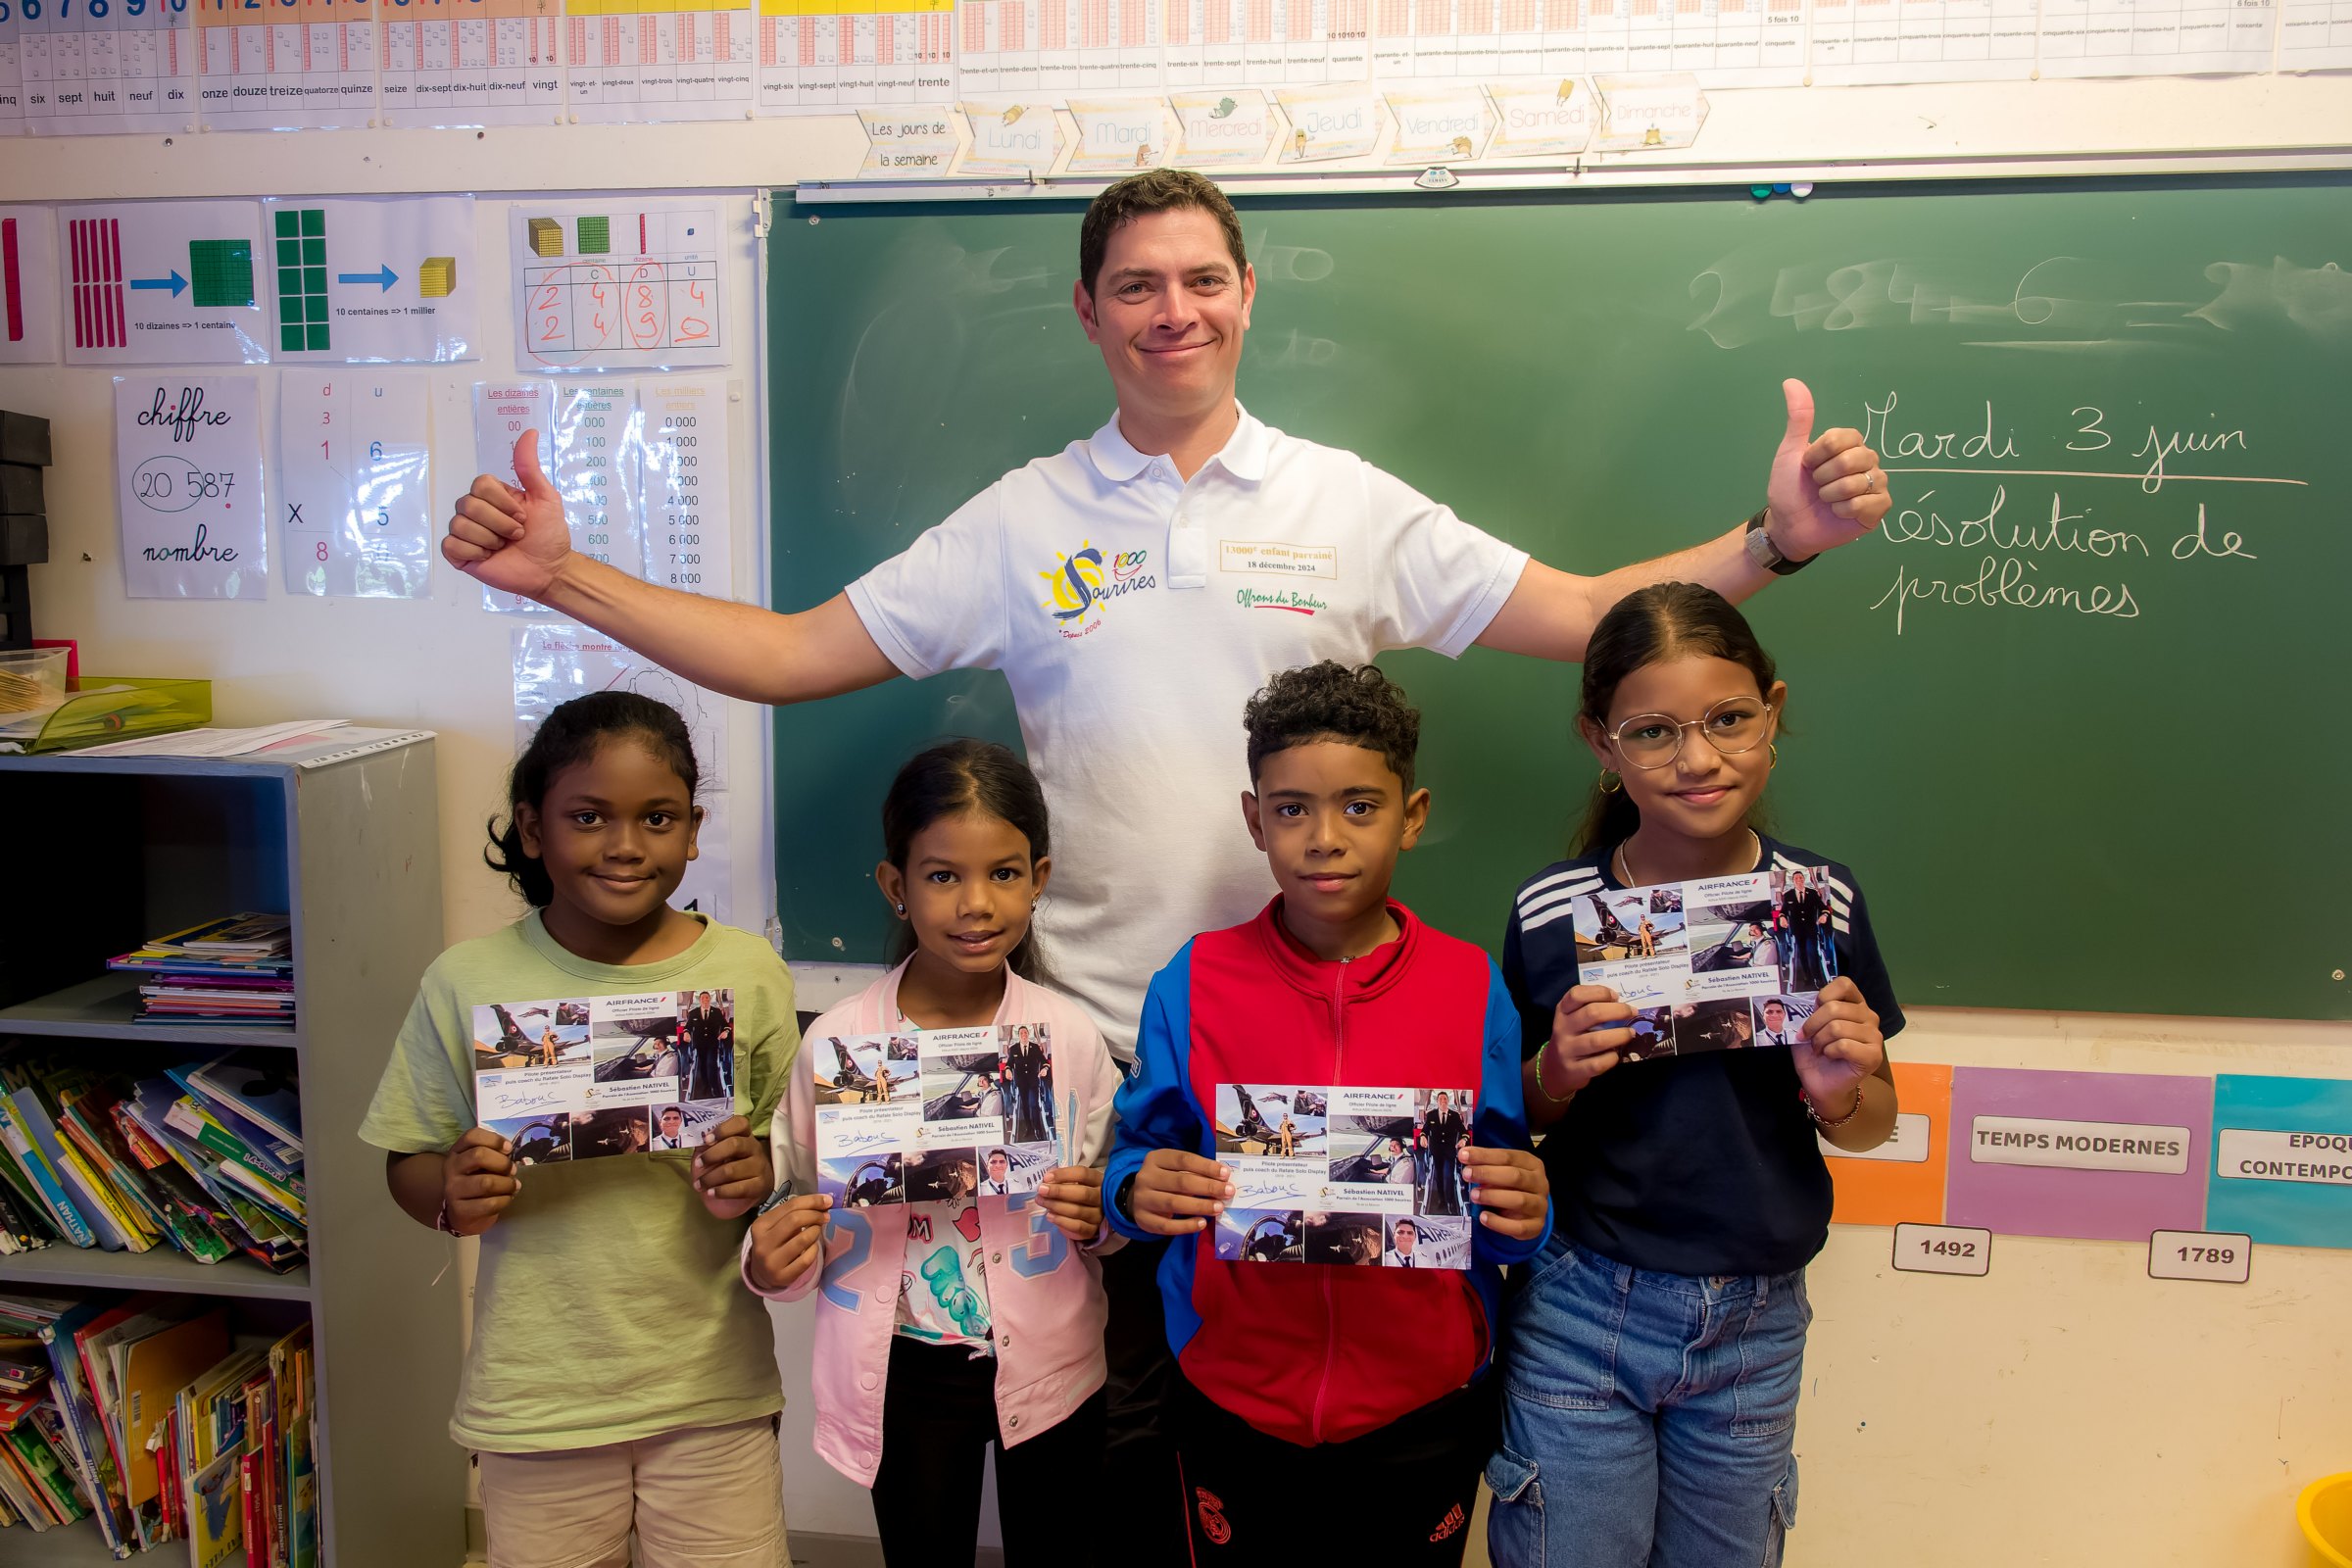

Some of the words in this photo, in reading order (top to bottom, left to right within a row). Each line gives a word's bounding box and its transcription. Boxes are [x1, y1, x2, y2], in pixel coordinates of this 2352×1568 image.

[416, 82, 452, 94] dix-sept
[453, 82, 487, 92] dix-huit
[489, 80, 526, 90] dix-neuf
[532, 79, 558, 91] vingt
[763, 82, 794, 91] vingt-six
[799, 81, 836, 90] vingt-sept
[839, 79, 874, 88] vingt-huit
[877, 79, 915, 89] vingt-neuf
[917, 77, 950, 87] trente
[168, 88, 184, 100] dix
[202, 89, 228, 99] onze
[233, 86, 268, 97] douze
[270, 85, 304, 96] treize
[304, 86, 339, 96] quatorze
[340, 83, 373, 95] quinze
[30, 94, 45, 104] six
[59, 91, 83, 106] sept
[94, 91, 116, 102] huit
[129, 90, 153, 101] neuf
[1509, 104, 1585, 128] Samedi
[1617, 104, 1691, 120] Dimanche
[1306, 107, 1362, 133] Jeudi
[1406, 114, 1479, 134] Vendredi
[872, 122, 893, 135] Les
[899, 122, 928, 137] jours
[933, 122, 947, 134] de
[1096, 122, 1152, 143] Mardi
[1191, 117, 1262, 139] Mercredi
[989, 128, 1041, 149] Lundi
[880, 154, 890, 166] la
[895, 153, 939, 166] semaine
[590, 270, 600, 280] C
[640, 269, 649, 278] D
[687, 267, 696, 276] U
[539, 285, 562, 311] 2
[592, 281, 606, 308] 4
[639, 285, 654, 309] 8
[690, 281, 705, 308] 4
[335, 308, 346, 317] 10
[348, 307, 389, 317] centaines
[411, 306, 436, 316] millier
[134, 322, 145, 331] 10
[146, 320, 180, 330] dizaines
[541, 316, 565, 340] 2
[594, 313, 607, 337] 4
[635, 312, 658, 338] 9
[322, 382, 331, 397] d
[374, 386, 383, 397] u
[488, 389, 504, 399] Les
[505, 388, 540, 399] dizaines
[137, 387, 231, 442] chiffre
[497, 404, 531, 416] entières
[321, 412, 331, 425] 3
[584, 416, 606, 428] 000
[665, 416, 672, 427] 0
[676, 416, 697, 427] 000
[508, 420, 521, 432] 00
[586, 436, 606, 448] 100
[1862, 390, 2020, 461] Mardi
[2066, 406, 2111, 450] 3
[2132, 424, 2248, 494] juin
[321, 439, 329, 460] 1
[369, 441, 382, 461] 6
[586, 456, 607, 467] 200
[140, 471, 172, 498] 20
[187, 471, 236, 498] 587
[588, 514, 609, 525] 500
[588, 534, 609, 545] 600
[2172, 503, 2258, 566] de
[143, 523, 239, 563] nombre
[317, 541, 329, 562] 8
[1260, 547, 1290, 558] enfant
[1293, 551, 1333, 563] parrainé
[1113, 550, 1148, 568] 1000
[1248, 561, 1257, 569] 18
[1259, 562, 1297, 572] décembre
[1298, 564, 1316, 573] 2024
[670, 573, 677, 584] 8
[680, 573, 702, 585] 000
[1052, 548, 1156, 621] Sourires
[1237, 588, 1274, 609] Offrons
[1275, 591, 1289, 605] du
[1292, 592, 1328, 611] Bonheur
[1870, 555, 2140, 635] problèmes
[1062, 630, 1083, 641] Depuis
[1085, 618, 1102, 634] 2006
[582, 642, 612, 652] montre
[1697, 879, 1750, 891] AIRFRANCE
[1741, 971, 1770, 981] NATIVEL
[606, 996, 659, 1007] AIRFRANCE
[933, 1032, 980, 1042] AIRFRANCE
[642, 1081, 670, 1091] NATIVEL
[1343, 1092, 1396, 1101] AIRFRANCE
[1977, 1129, 2050, 1151] TEMPS
[2055, 1136, 2180, 1157] MODERNES
[57, 1200, 88, 1241] NATHAN
[1920, 1240, 1977, 1258] 1492
[2177, 1247, 2234, 1265] 1789
